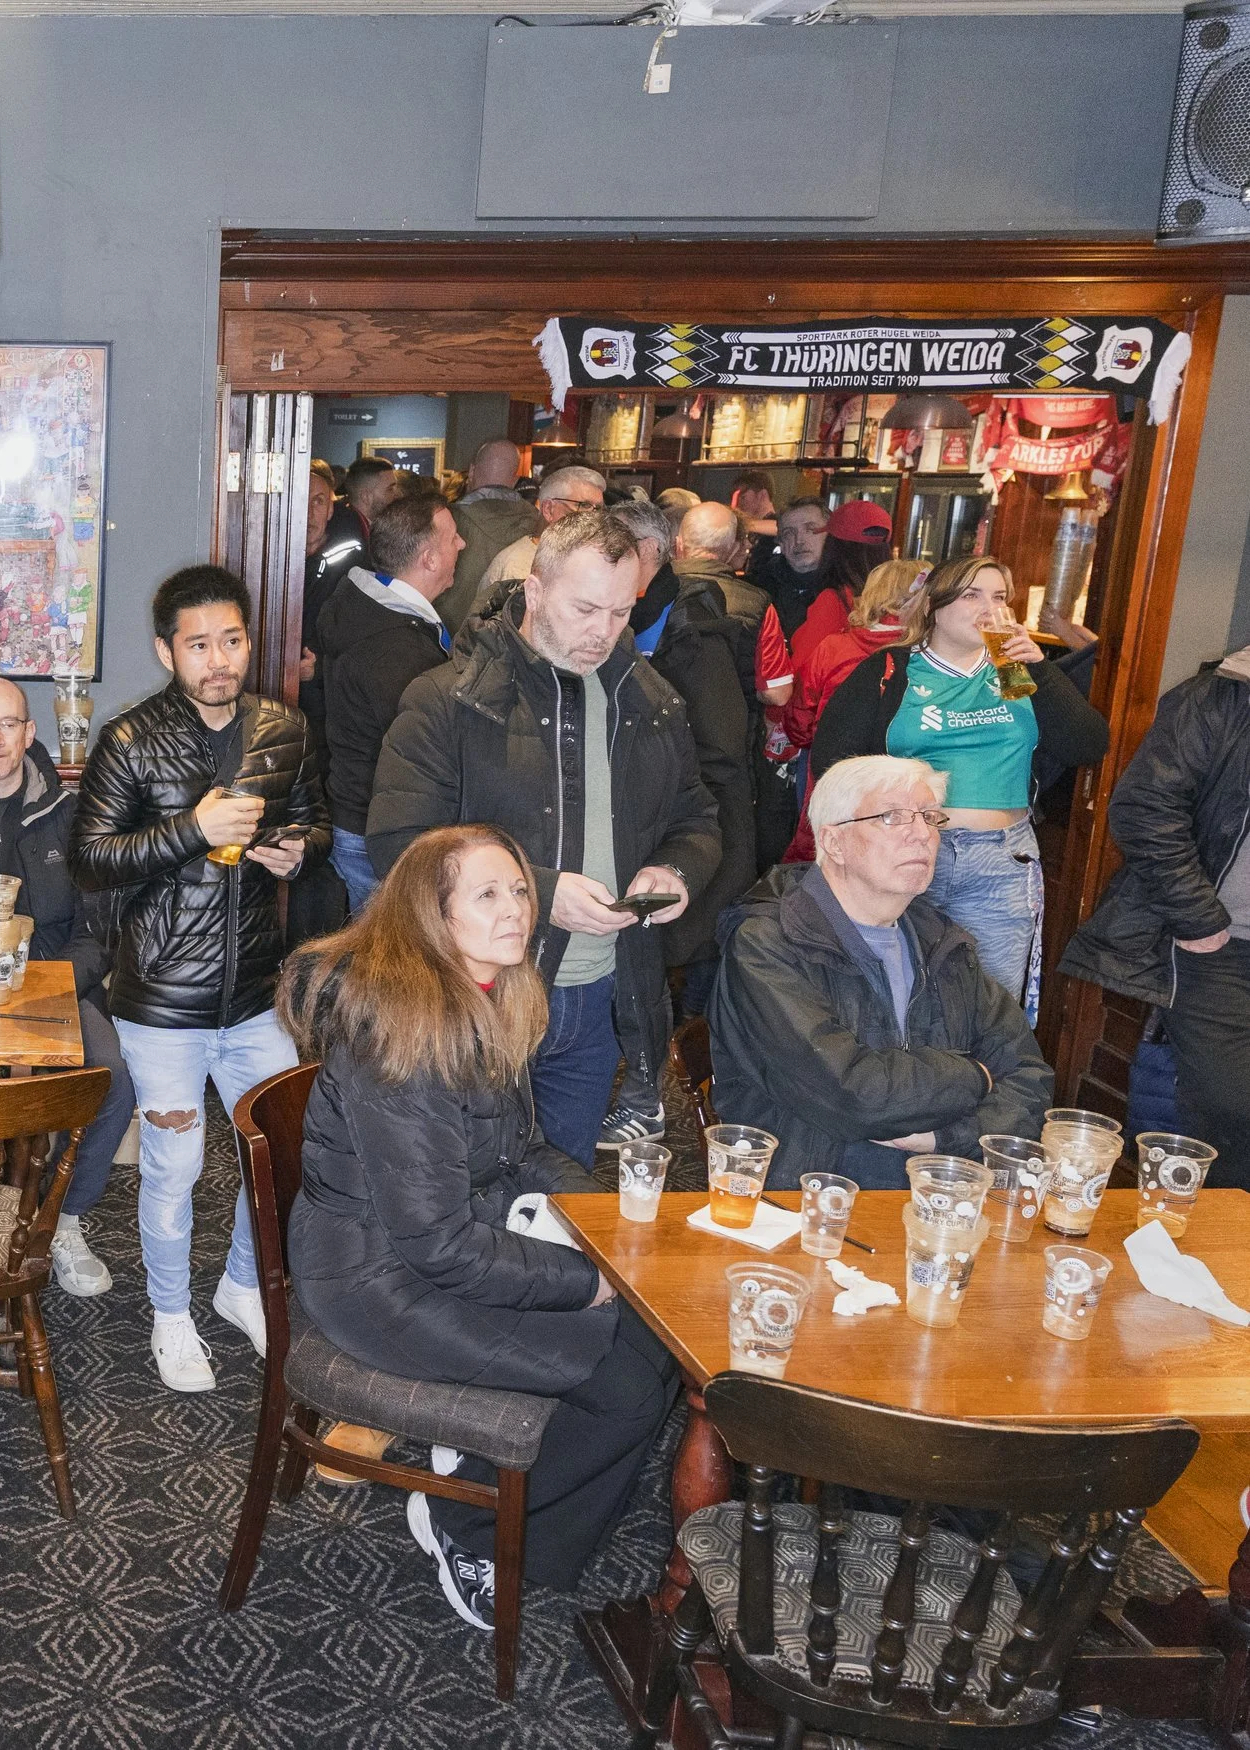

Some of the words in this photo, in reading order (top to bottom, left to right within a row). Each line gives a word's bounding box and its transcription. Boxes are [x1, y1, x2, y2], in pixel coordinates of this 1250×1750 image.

[796, 331, 848, 342] SPORTPARK
[850, 329, 879, 339] ROTER
[912, 330, 941, 338] WEIDA
[728, 346, 761, 372] FC
[769, 341, 911, 373] THÜRINGEN
[922, 341, 1006, 372] WEIDA
[811, 375, 868, 388] TRADITION
[871, 375, 895, 387] SEIT
[897, 375, 919, 387] 1909
[1010, 443, 1069, 465] ARKLES
